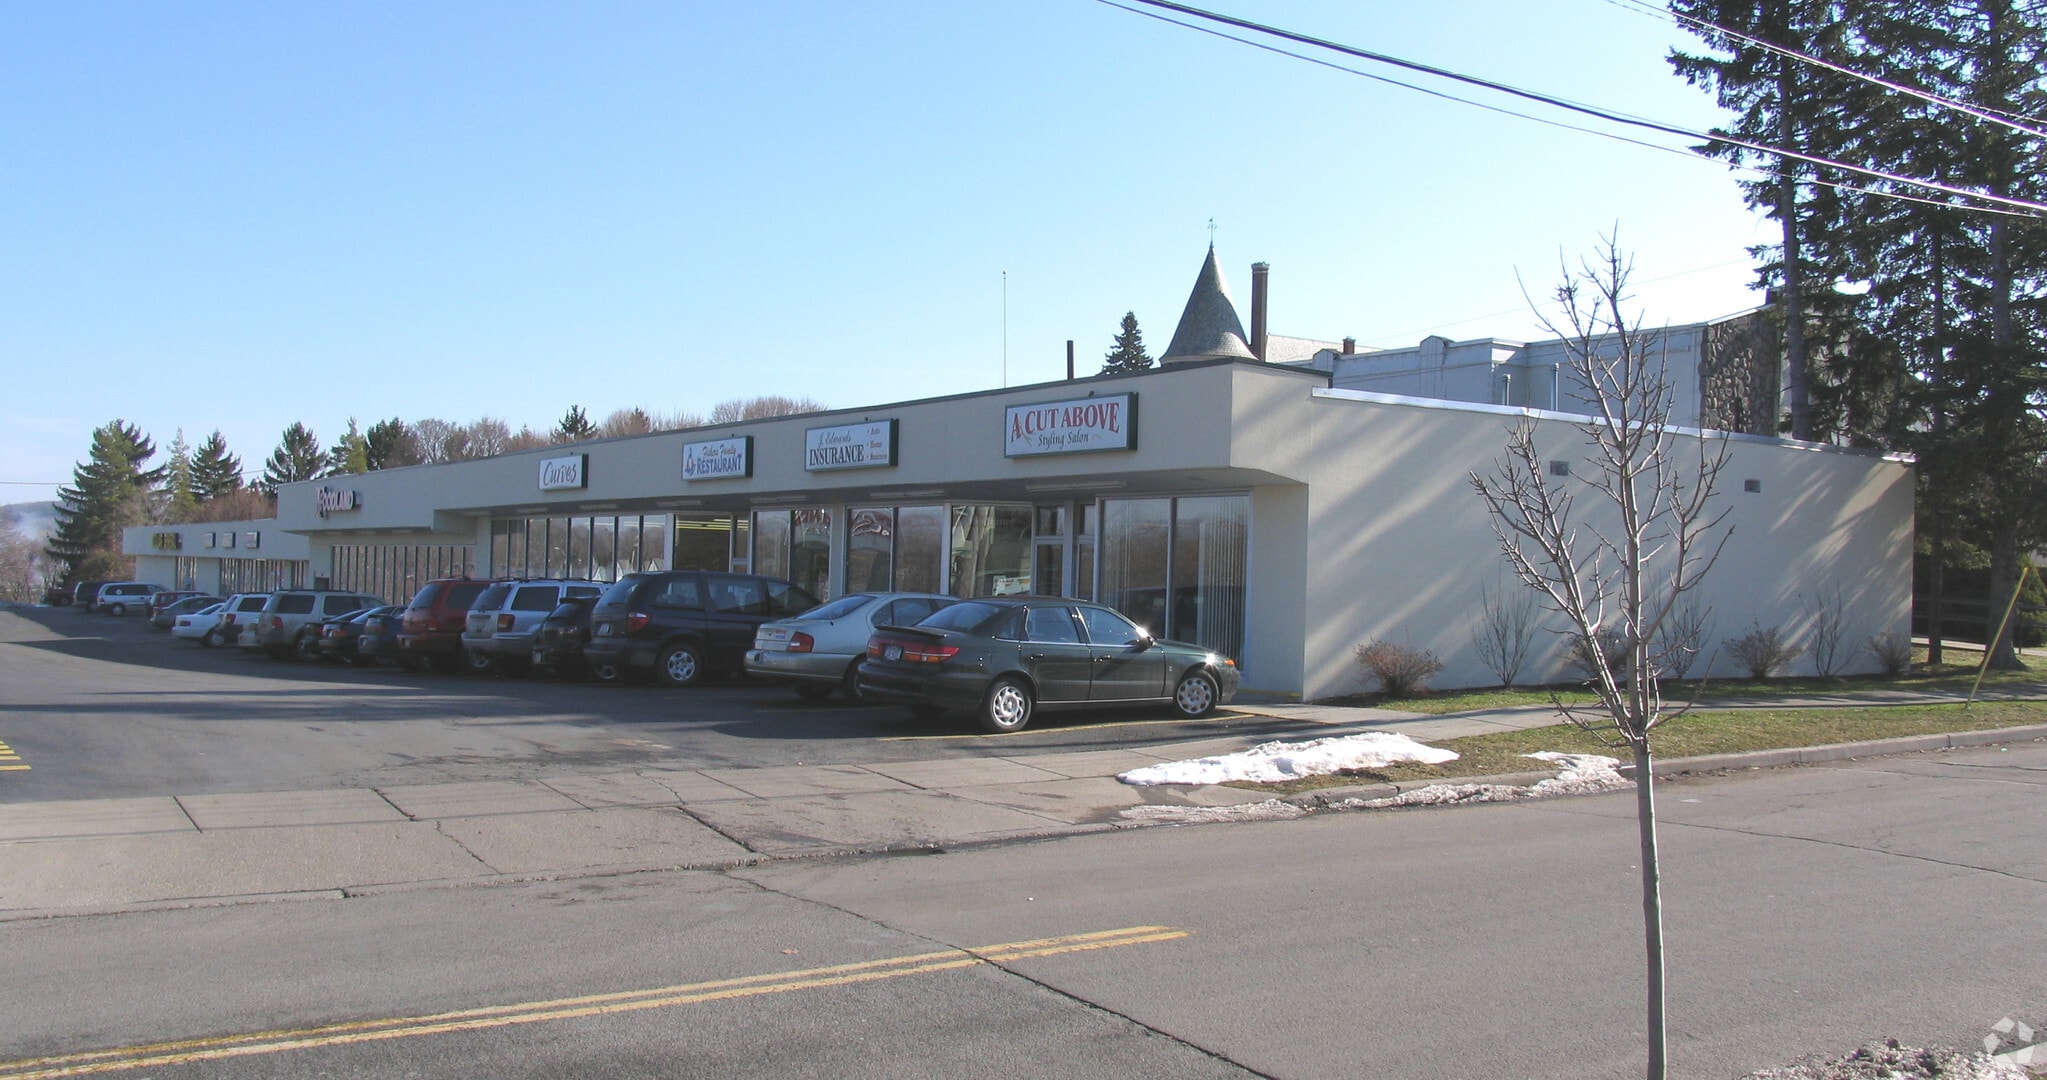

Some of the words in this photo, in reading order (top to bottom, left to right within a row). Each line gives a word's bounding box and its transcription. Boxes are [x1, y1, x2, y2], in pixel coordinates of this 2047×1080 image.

[1010, 412, 1022, 443] A
[1024, 408, 1059, 435] CUT
[1060, 402, 1120, 434] ABOVE
[1038, 430, 1065, 450] Styling
[1067, 428, 1089, 444] Salon
[696, 453, 743, 475] RESTAURANT
[809, 444, 865, 466] INSURANCE
[543, 461, 577, 486] Curves
